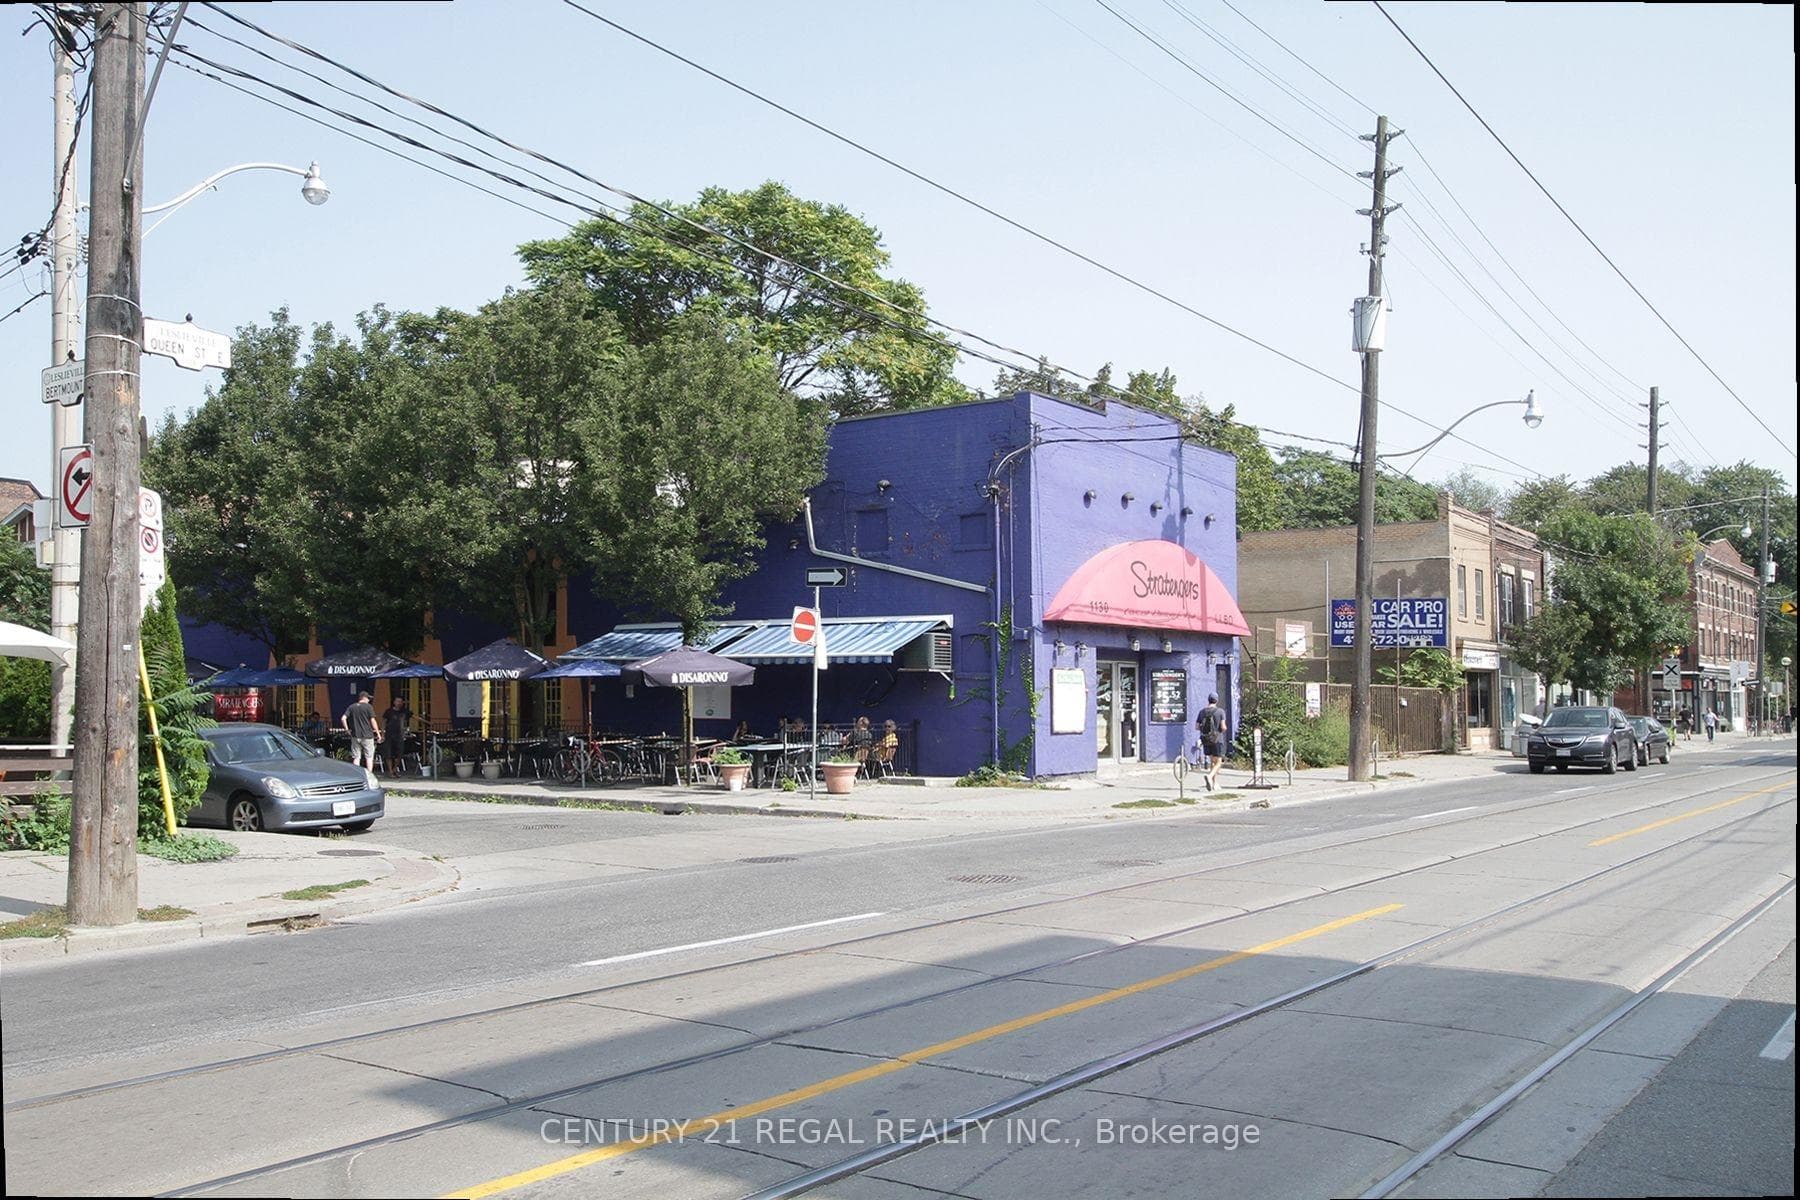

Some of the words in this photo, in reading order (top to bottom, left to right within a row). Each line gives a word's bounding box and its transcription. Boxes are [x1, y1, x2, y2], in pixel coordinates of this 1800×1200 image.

[151, 338, 185, 355] QUEEN
[195, 347, 206, 359] ST
[217, 352, 223, 364] E
[50, 367, 84, 383] LESLIEVILL
[46, 379, 84, 399] BERTMOUNT
[1380, 601, 1411, 614] CAR
[1414, 601, 1444, 614] PRO
[1334, 621, 1356, 630] USE
[1370, 621, 1387, 630] AR
[1387, 613, 1444, 629] SALE!
[334, 665, 377, 675] DISARONNO
[475, 669, 521, 681] DISARONNO
[679, 671, 729, 684] DISARONNO
